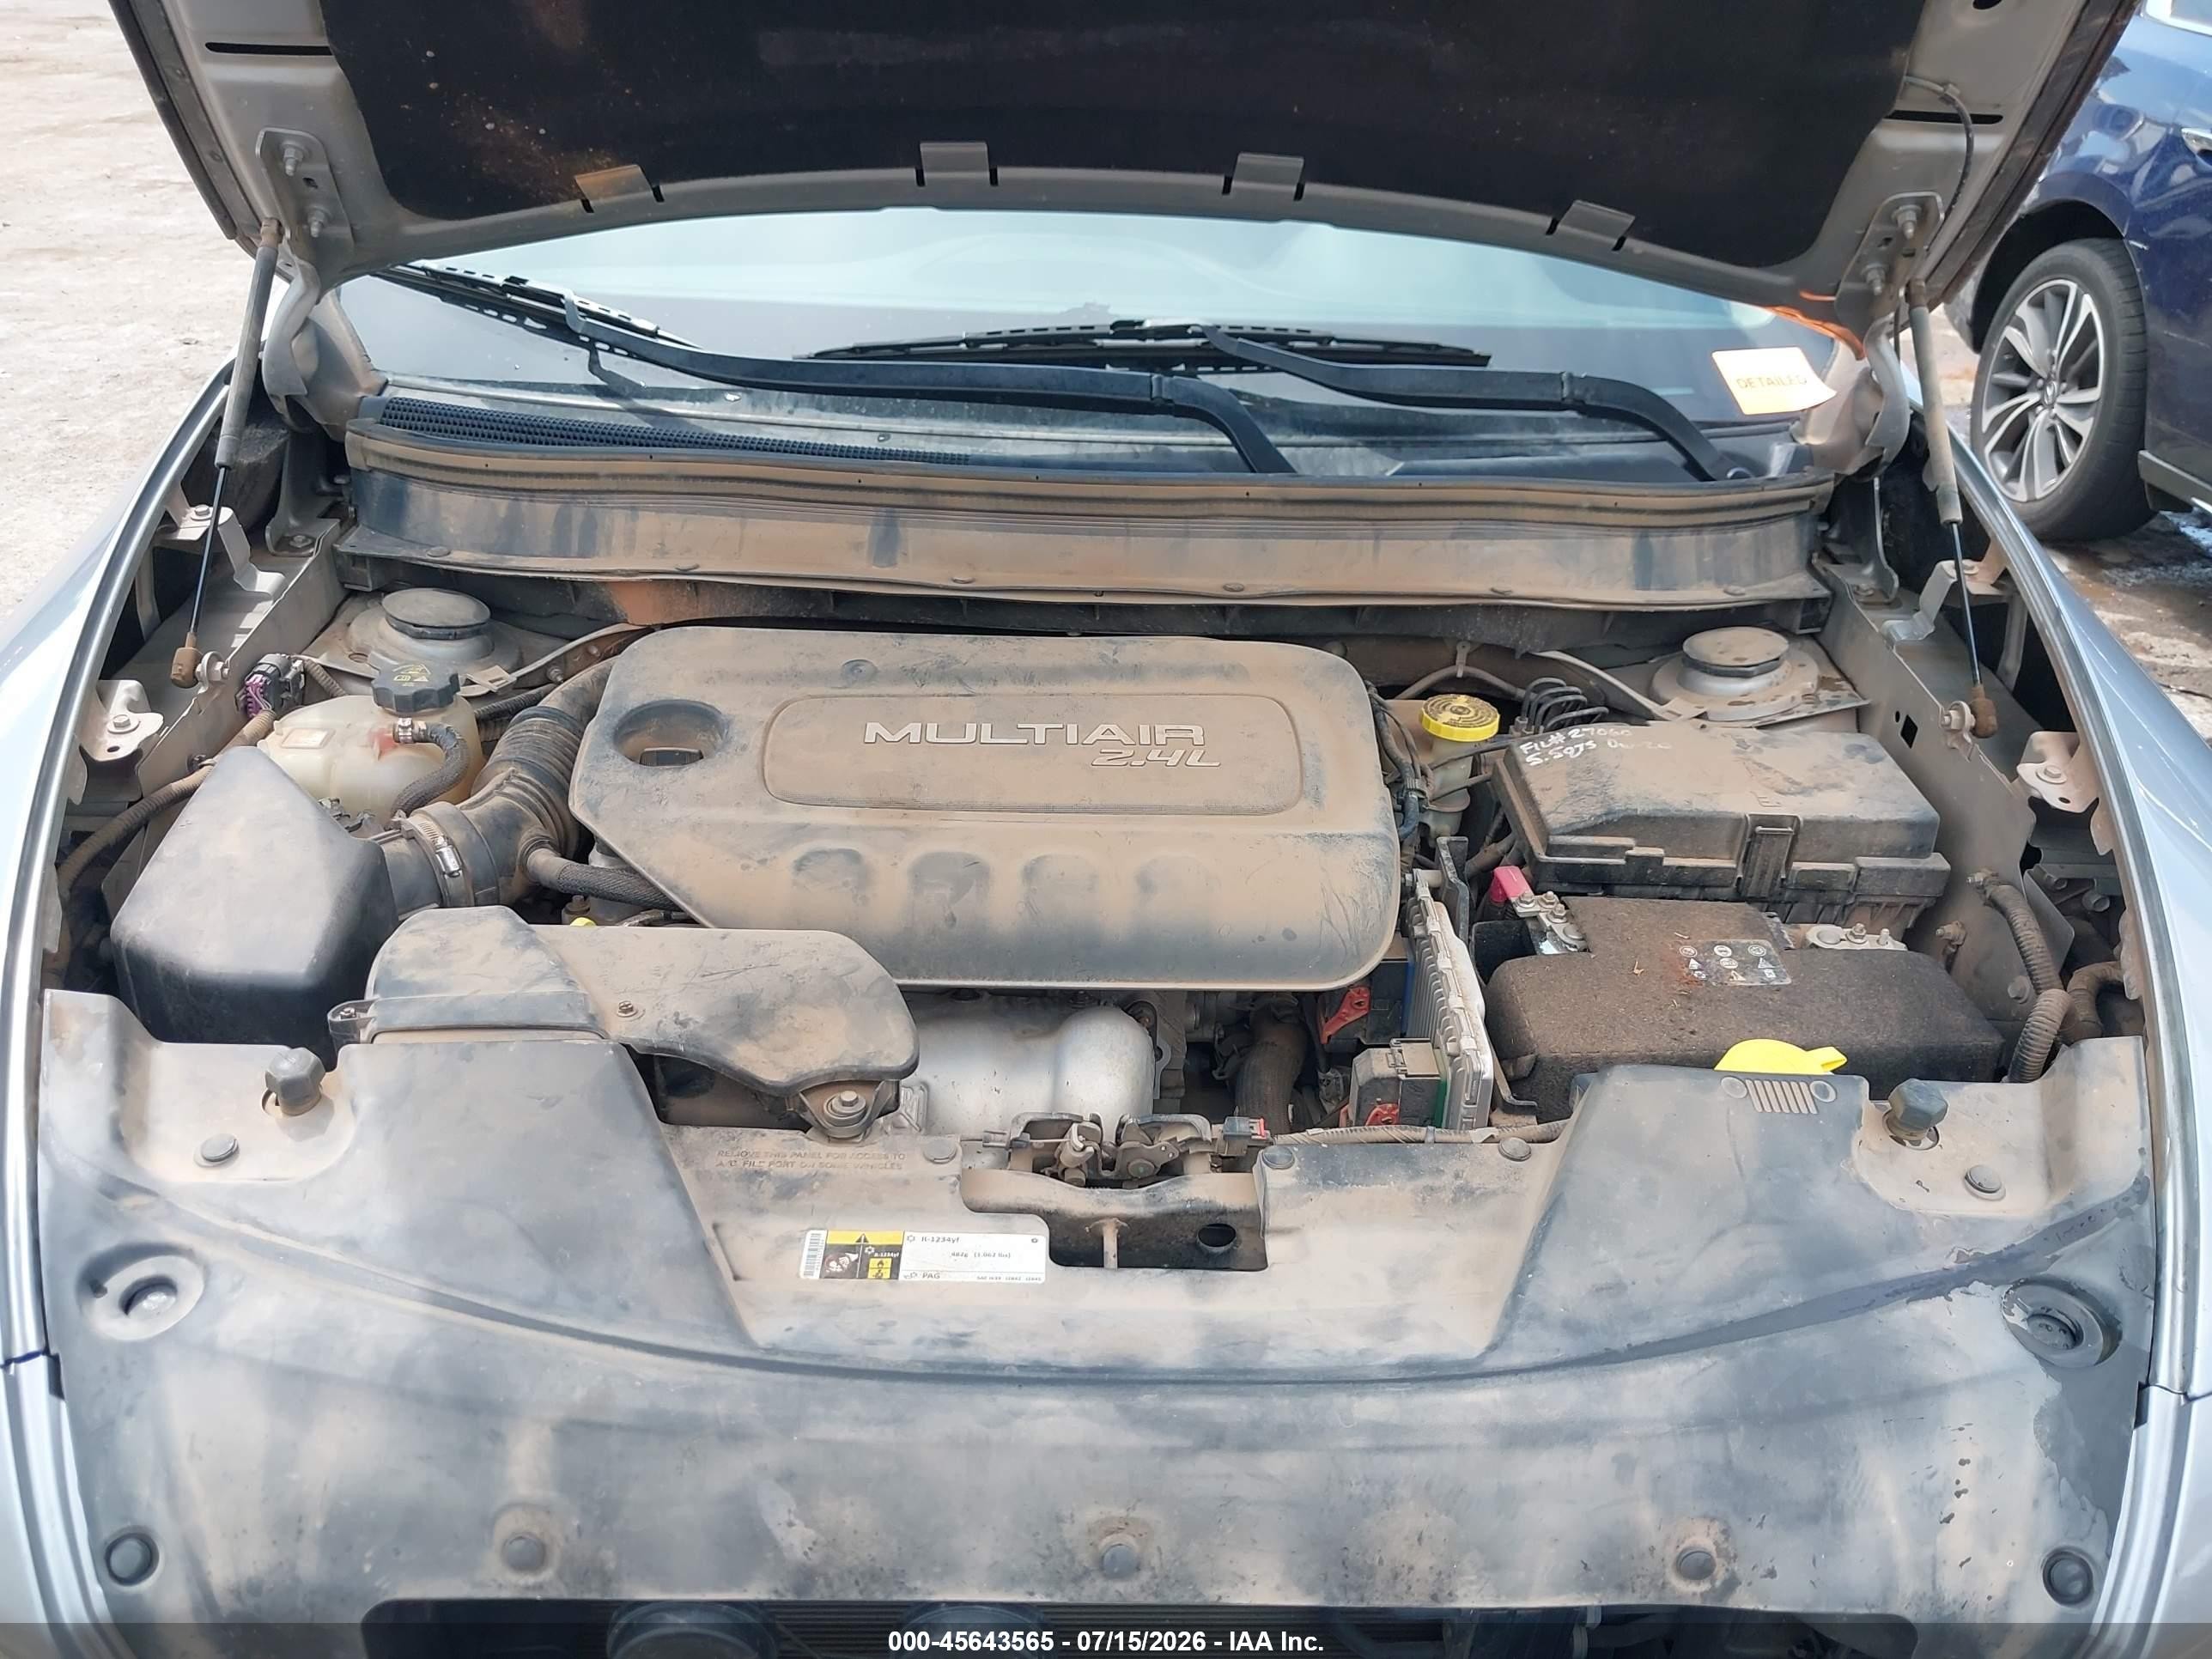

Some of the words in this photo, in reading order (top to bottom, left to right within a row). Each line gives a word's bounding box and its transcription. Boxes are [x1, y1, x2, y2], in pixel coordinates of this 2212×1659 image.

[864, 721, 1206, 745] MULTIAIR
[1091, 748, 1220, 767] 2.4L
[892, 1152, 907, 1161] TO
